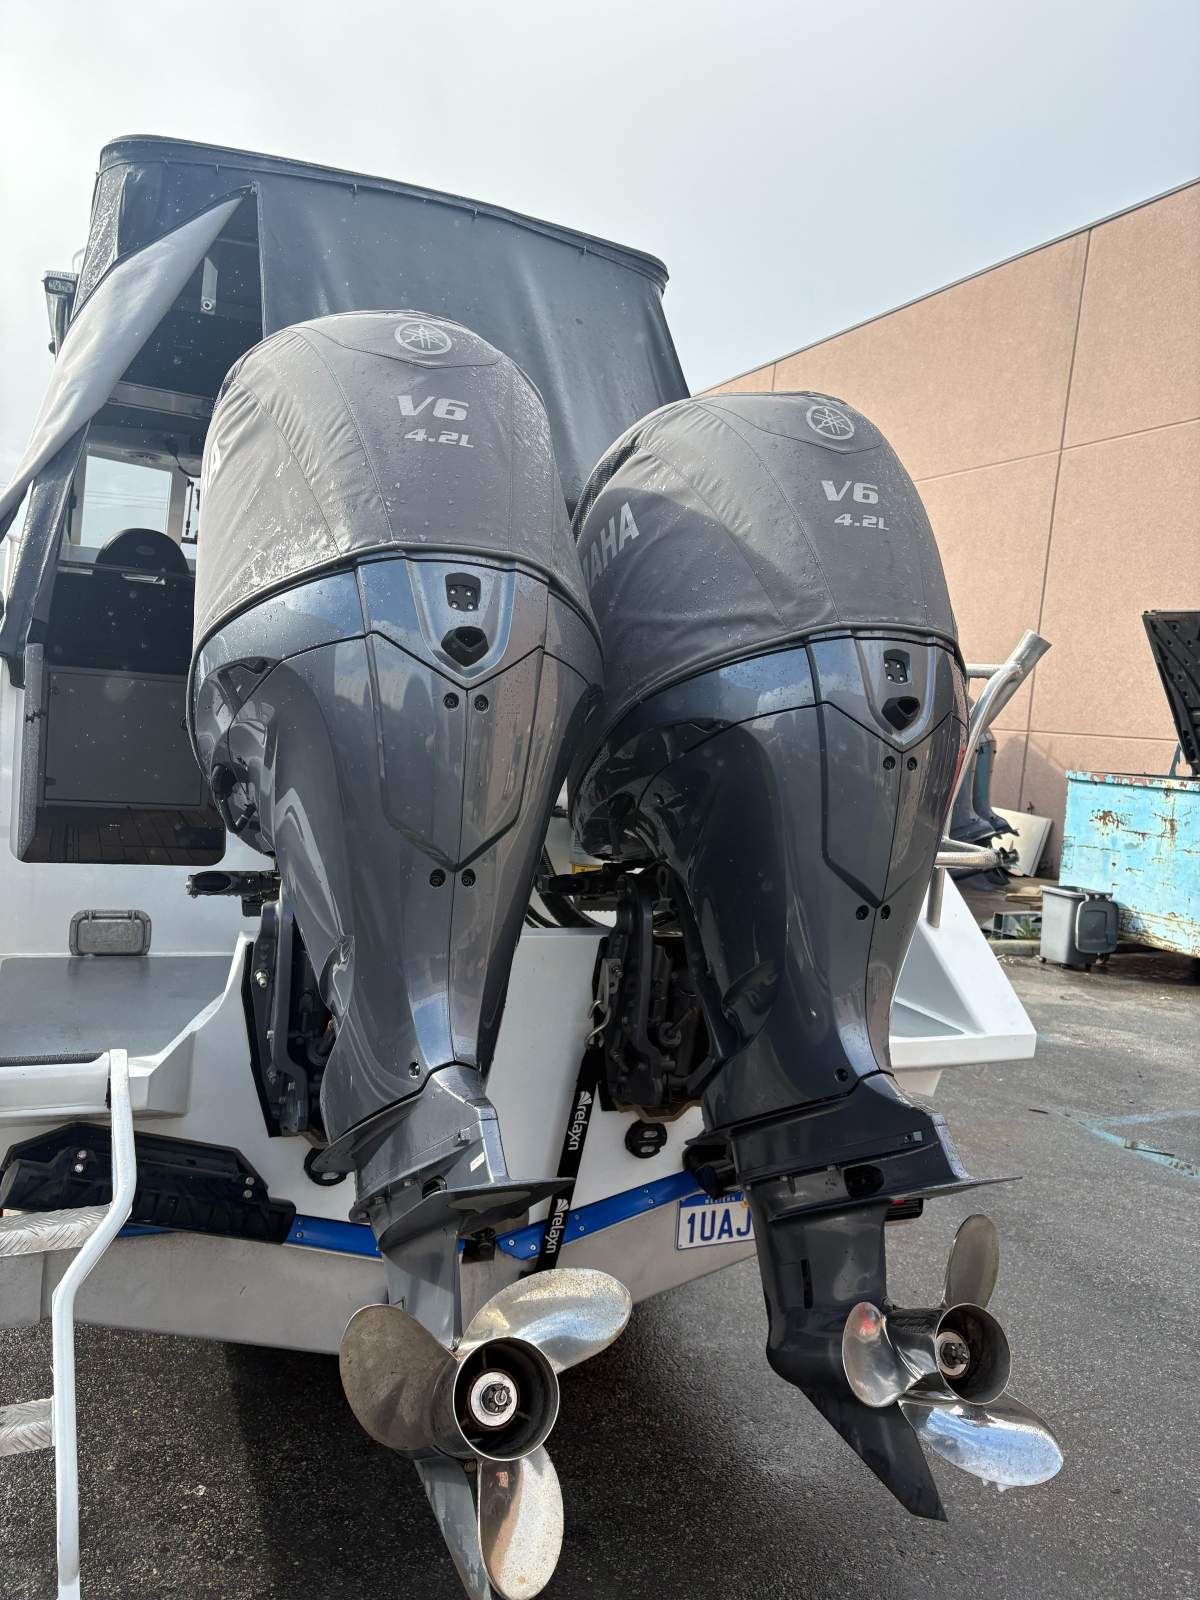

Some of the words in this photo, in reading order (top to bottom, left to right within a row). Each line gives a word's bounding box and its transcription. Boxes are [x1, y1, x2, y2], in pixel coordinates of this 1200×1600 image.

[398, 395, 469, 420] V6
[404, 429, 474, 448] 4.2L
[821, 480, 879, 504] V6
[834, 513, 890, 530] 4.2L
[568, 1105, 588, 1150] relaxn
[545, 1212, 565, 1254] relaxn
[687, 1208, 752, 1243] 1UAJ
